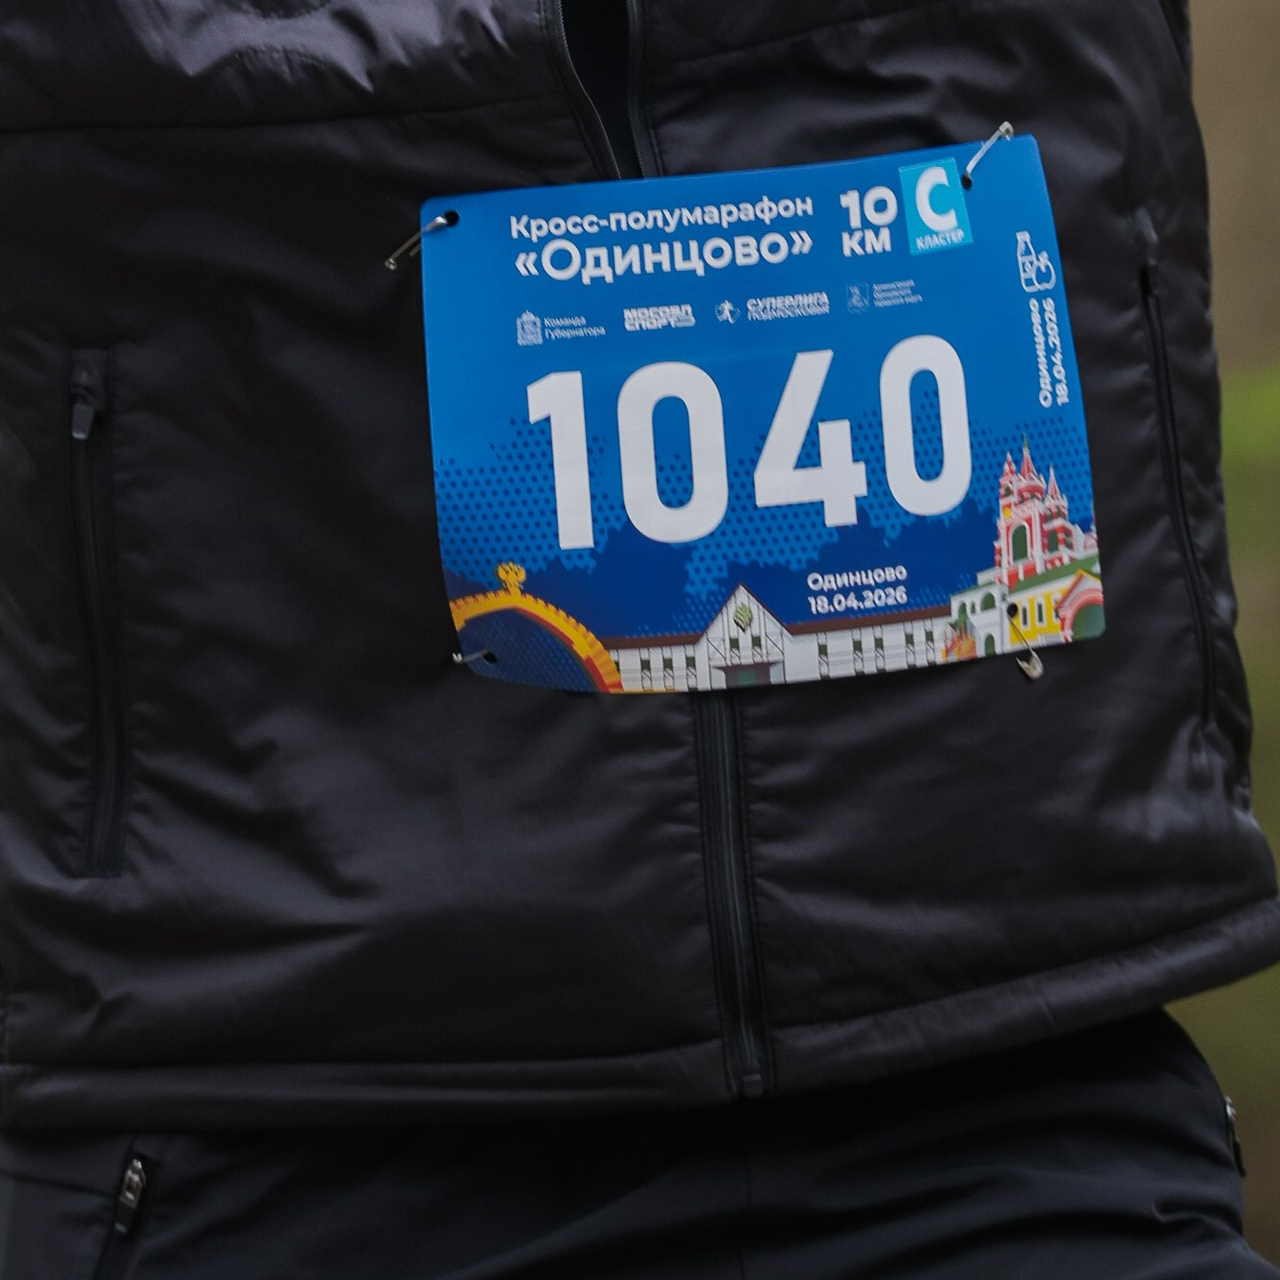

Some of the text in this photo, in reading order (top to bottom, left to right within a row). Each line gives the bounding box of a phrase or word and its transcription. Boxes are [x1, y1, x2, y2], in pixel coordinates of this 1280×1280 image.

[510, 196, 814, 243] Кросс-полумарафон
[839, 185, 898, 230] 10
[915, 228, 965, 252] КЛАСТЕР
[526, 334, 972, 550] 1040
[807, 565, 908, 593] Одинцово
[807, 585, 908, 615] 18.04.2026
